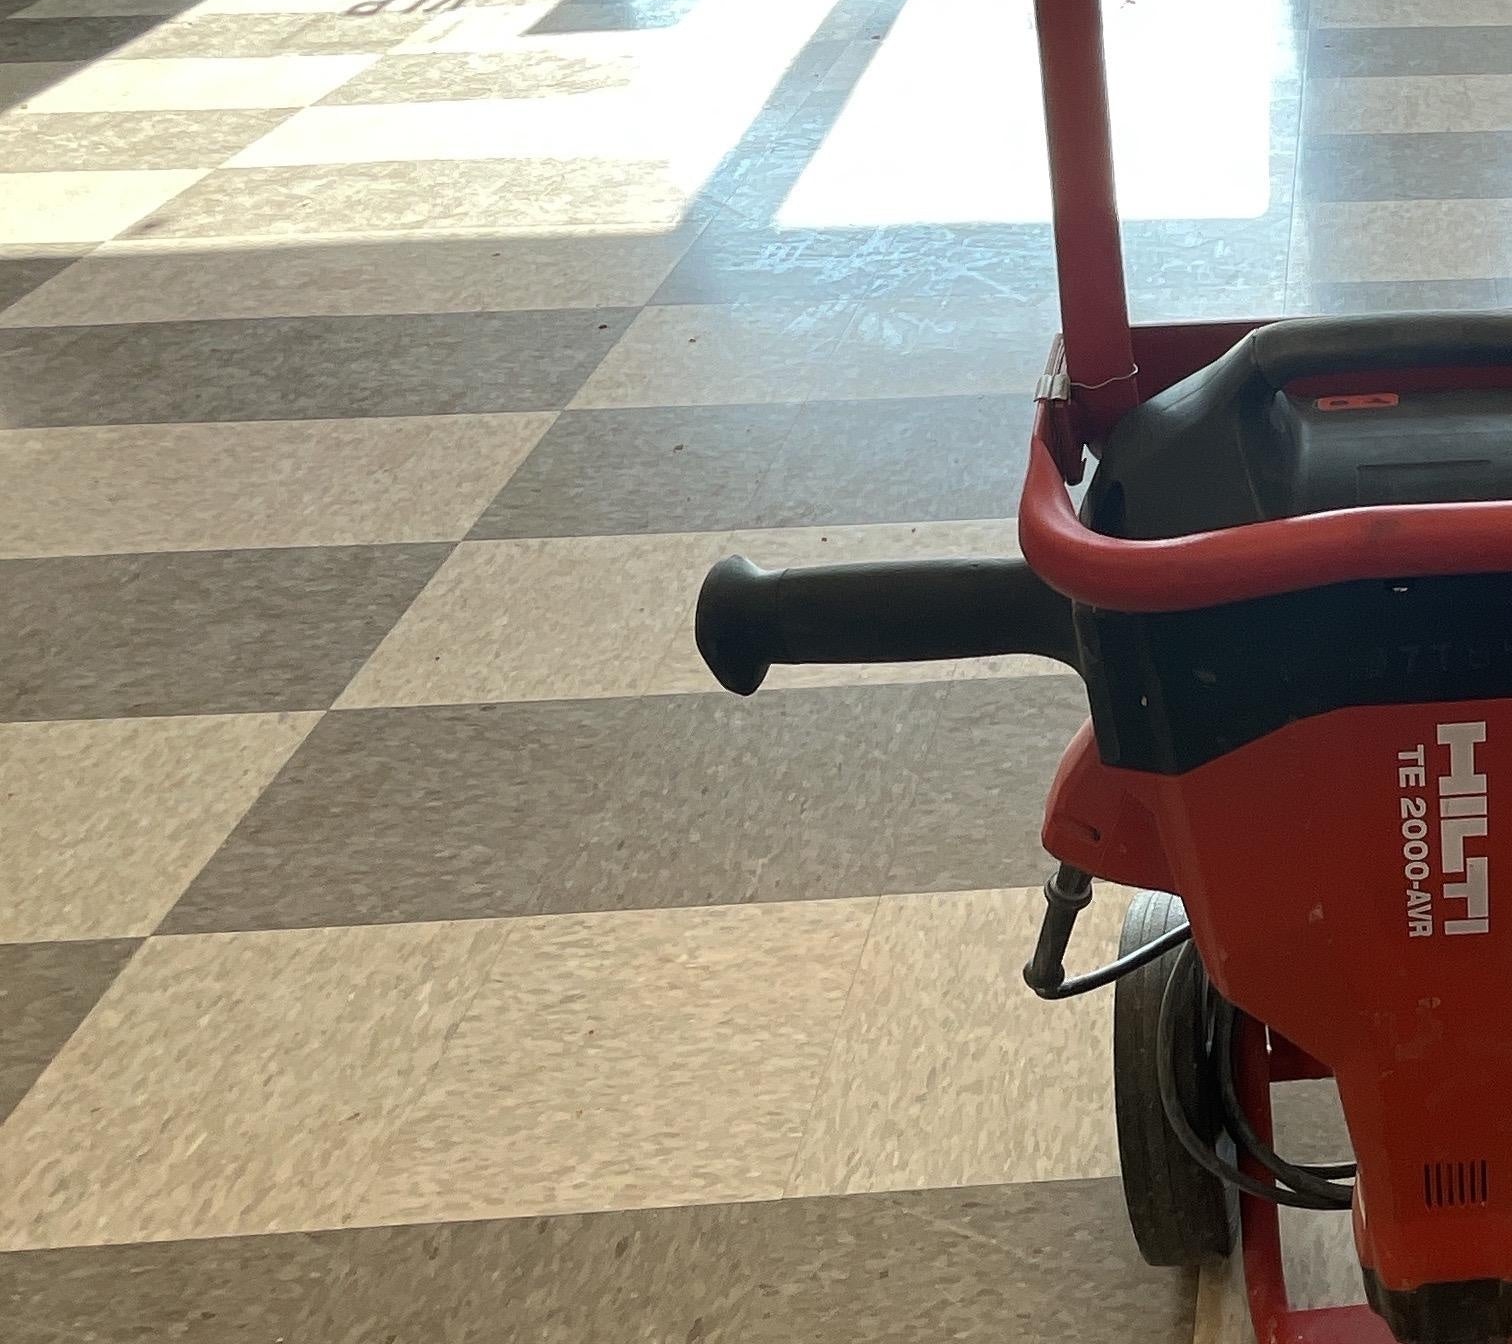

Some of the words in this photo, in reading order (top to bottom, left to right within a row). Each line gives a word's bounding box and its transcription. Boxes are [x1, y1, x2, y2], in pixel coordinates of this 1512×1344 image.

[1398, 744, 1427, 787] TE
[1437, 720, 1489, 936] HILTI
[1400, 793, 1433, 939] 2000-AVR
